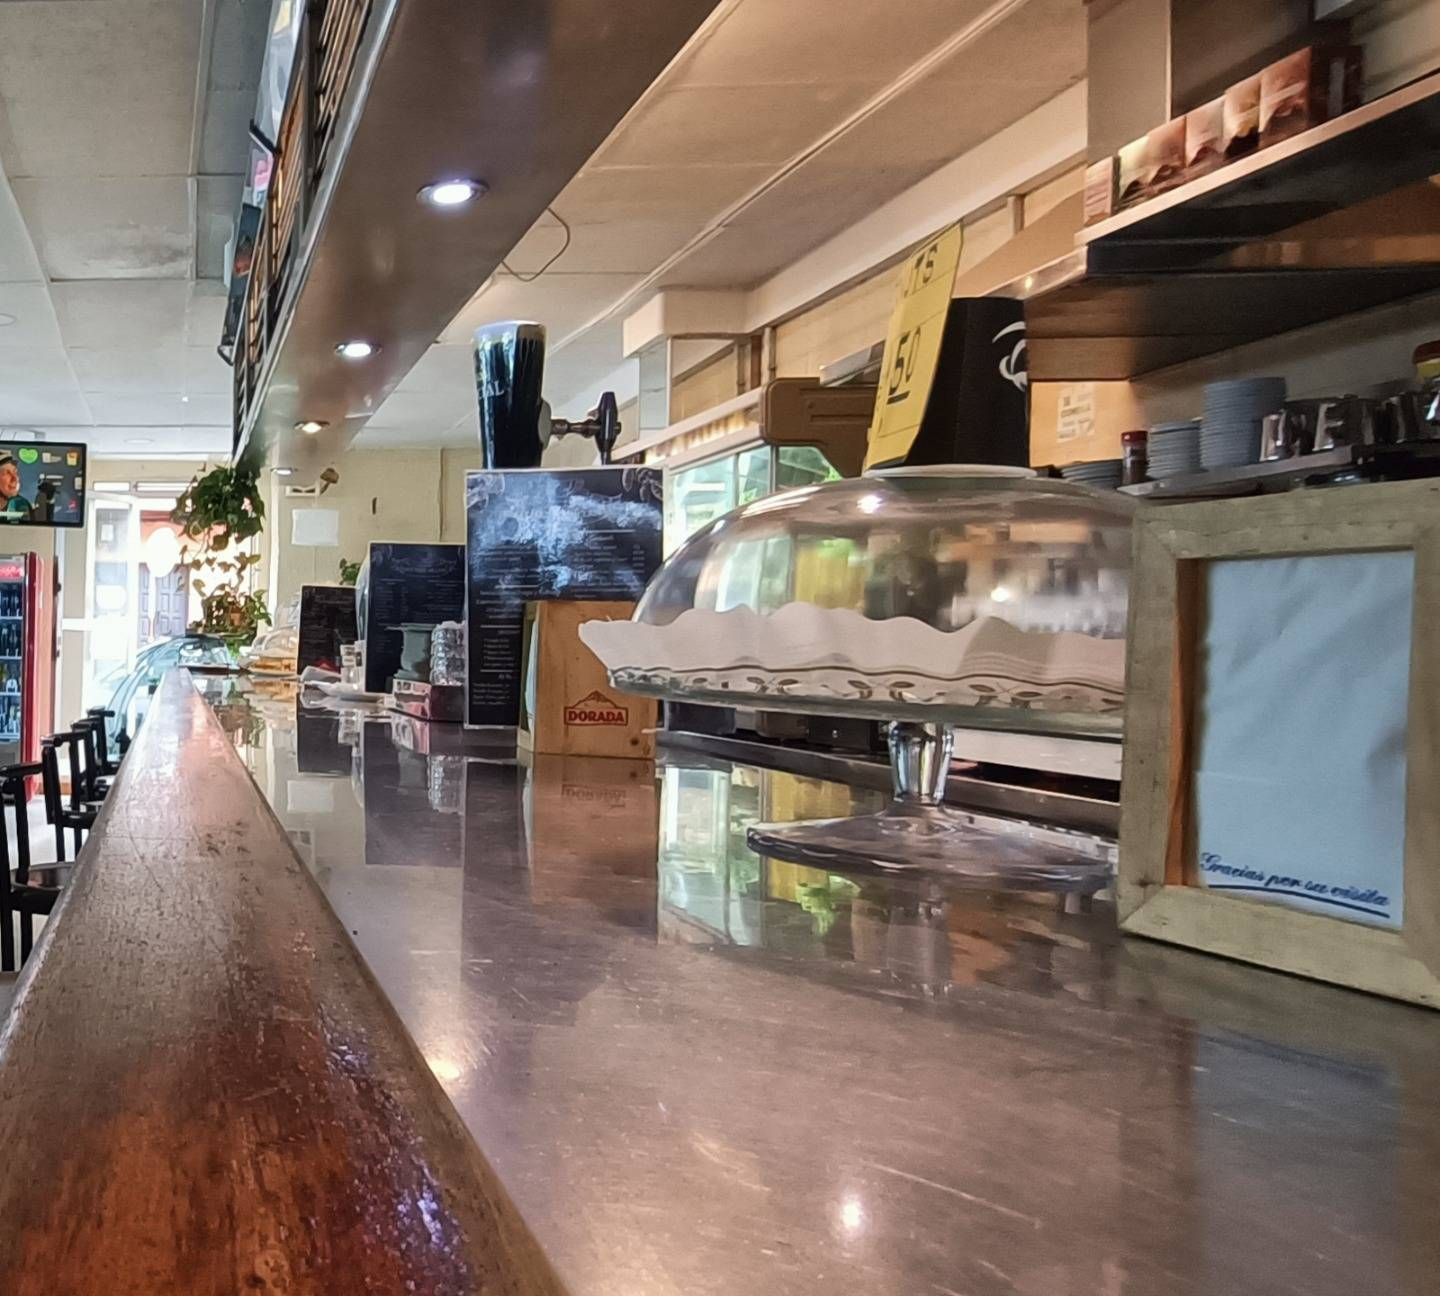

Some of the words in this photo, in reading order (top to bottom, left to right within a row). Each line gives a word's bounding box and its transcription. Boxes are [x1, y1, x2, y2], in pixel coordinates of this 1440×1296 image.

[568, 710, 625, 722] DORADA
[1201, 852, 1265, 882] Gracias
[1264, 874, 1301, 887] por
[1304, 881, 1330, 894] su
[1331, 885, 1390, 906] visita
